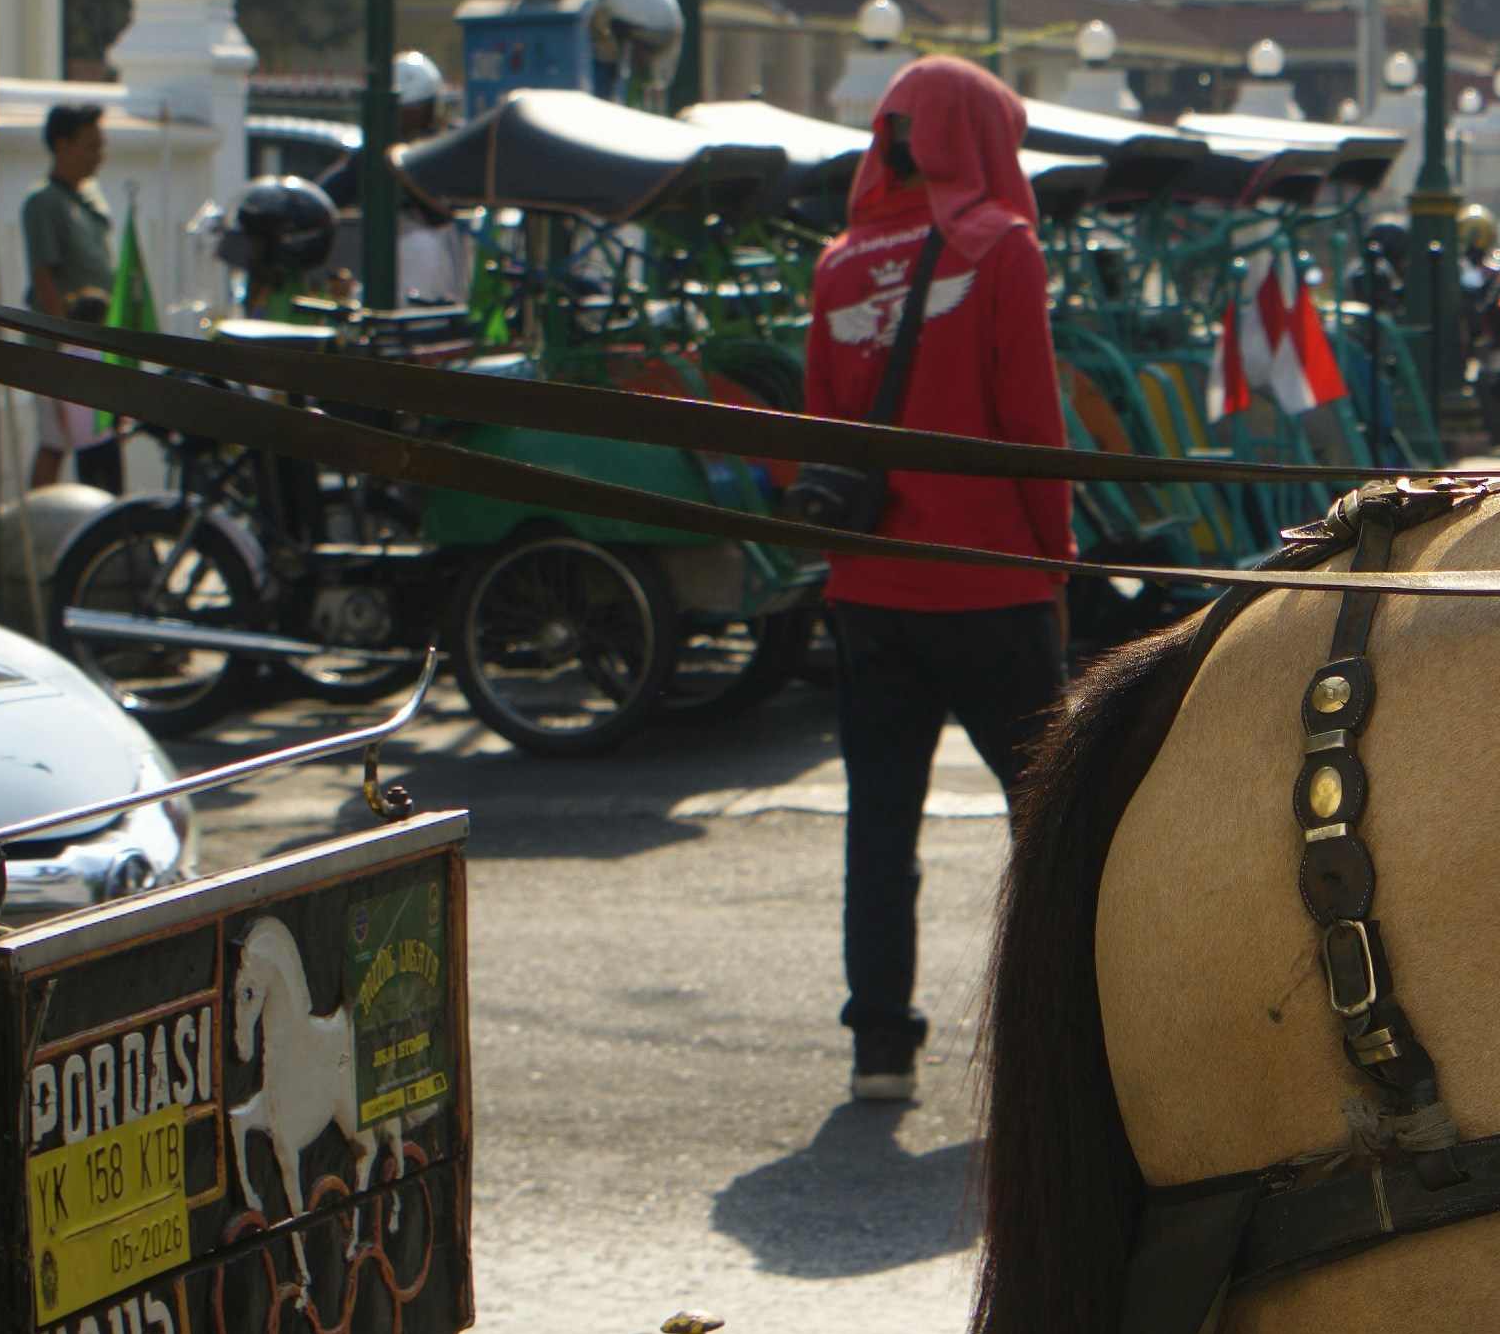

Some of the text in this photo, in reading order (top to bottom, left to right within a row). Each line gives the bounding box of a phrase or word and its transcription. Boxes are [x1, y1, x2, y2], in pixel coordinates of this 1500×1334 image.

[29, 1007, 213, 1152] PORDASI
[38, 1122, 180, 1227] YK 158 KTB
